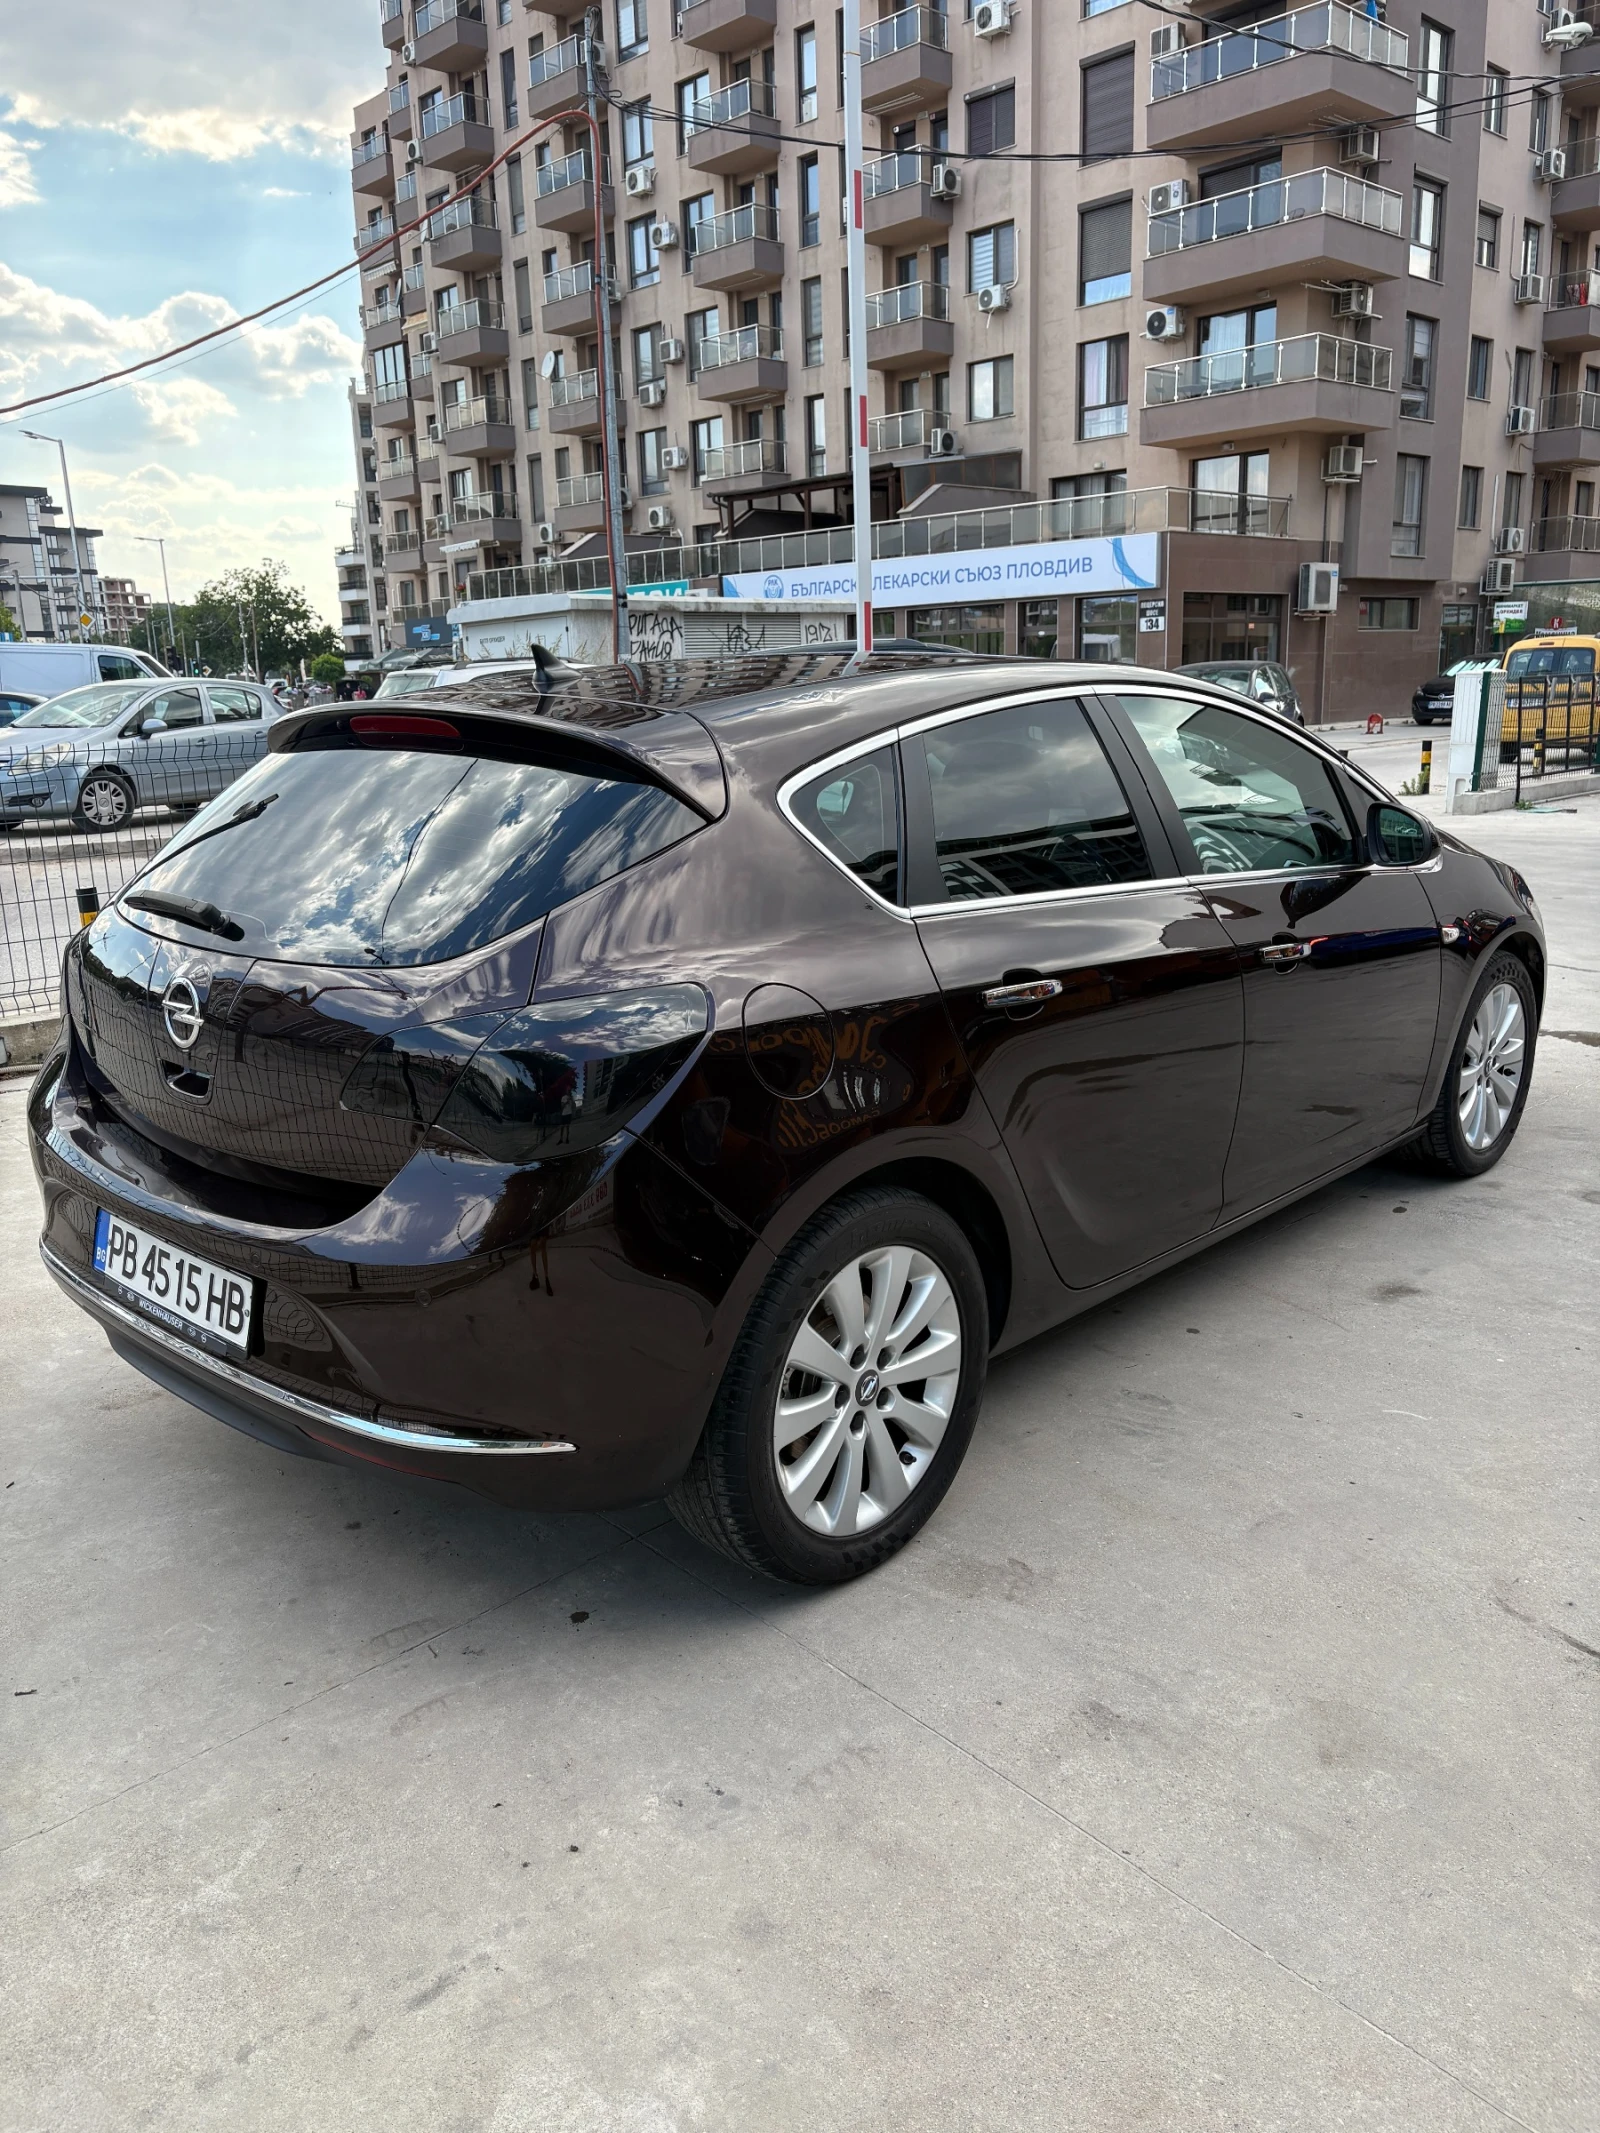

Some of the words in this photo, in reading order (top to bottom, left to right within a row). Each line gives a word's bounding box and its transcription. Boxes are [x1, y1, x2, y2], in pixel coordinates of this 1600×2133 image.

[791, 579, 857, 597] БЪЛГАРСК
[872, 570, 950, 591] ЛЕКАРСКИ
[954, 565, 1002, 583] СЪЮЗ
[1006, 556, 1093, 579] ПЛОВДИВ
[628, 612, 683, 643] РИГАДА
[1144, 618, 1160, 631] 134
[96, 1246, 106, 1263] BG
[107, 1223, 138, 1280] PB
[141, 1244, 202, 1314] 4515
[205, 1273, 244, 1335] HB
